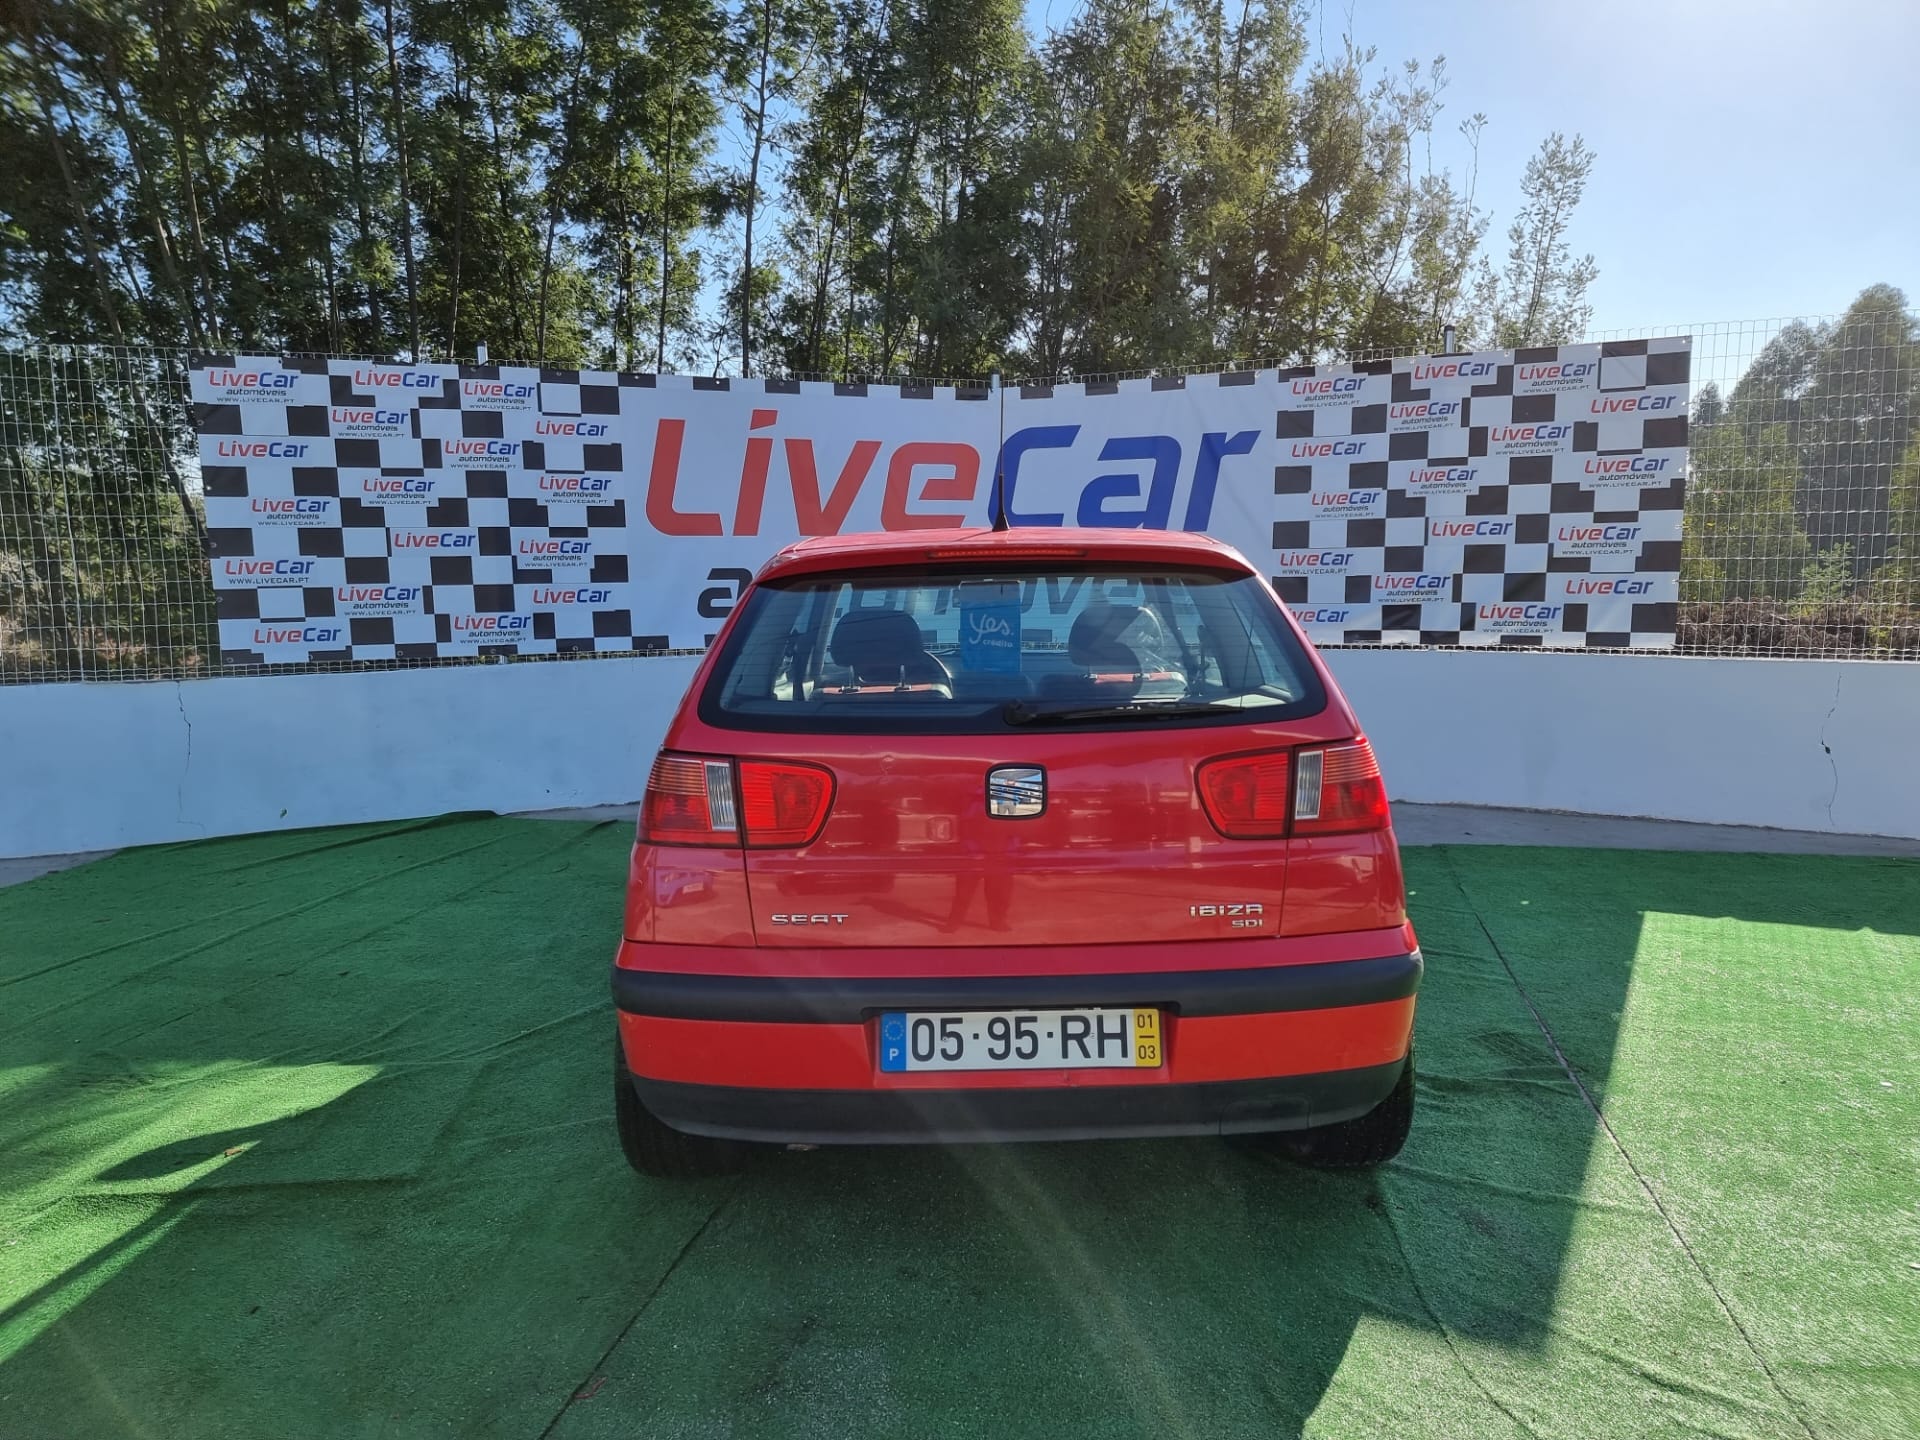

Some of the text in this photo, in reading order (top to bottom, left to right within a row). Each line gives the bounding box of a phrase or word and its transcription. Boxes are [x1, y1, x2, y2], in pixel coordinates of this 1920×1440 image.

[1415, 362, 1495, 380] LiveCar
[1518, 361, 1596, 380] LiveCar
[210, 370, 299, 389] LiveCar
[355, 370, 440, 388] LiveCar
[1291, 377, 1366, 395] LiveCar
[1531, 377, 1585, 387] automóveis
[226, 388, 286, 396] automóveis
[465, 382, 535, 398] LiveCar
[1304, 392, 1355, 402] automóveis
[477, 396, 526, 404] automóveis
[1591, 396, 1676, 413] LiveCar
[333, 409, 408, 424] LiveCar
[1390, 401, 1459, 419] LiveCar
[347, 423, 398, 431] automóveis
[1400, 415, 1448, 424] automóveis
[536, 420, 608, 436] LiveCar
[1492, 425, 1571, 441] LiveCar
[219, 441, 308, 458] LiveCar
[445, 440, 520, 456] LiveCar
[1292, 442, 1366, 457] LiveCar
[1504, 440, 1559, 449] automóveis
[646, 408, 1261, 537] LiveCar
[1585, 457, 1669, 474] LiveCar
[1410, 468, 1478, 482] LiveCar
[1597, 471, 1655, 481] automóveis
[364, 479, 435, 492] LiveCar
[540, 476, 611, 491] LiveCar
[1420, 480, 1466, 489] automóveis
[252, 498, 330, 512] LiveCar
[1312, 491, 1380, 506] LiveCar
[1322, 504, 1368, 512] automóveis
[1432, 521, 1513, 536] LiveCar
[1559, 526, 1641, 542] LiveCar
[395, 533, 476, 547] LiveCar
[520, 540, 591, 553] LiveCar
[1280, 552, 1354, 566] LiveCar
[226, 560, 315, 574] LiveCar
[1375, 575, 1451, 589] LiveCar
[1566, 579, 1653, 594] LiveCar
[338, 586, 420, 602] LiveCar
[533, 588, 612, 604] LiveCar
[352, 600, 408, 609] automóveis
[1480, 604, 1561, 619] LiveCar
[455, 615, 531, 630] LiveCar
[255, 628, 342, 643] LiveCar
[1190, 904, 1263, 917] IBIZA
[771, 914, 849, 925] SEAT
[1231, 919, 1263, 928] SDI
[1137, 1014, 1153, 1029] 01
[889, 1048, 899, 1061] P
[1138, 1045, 1156, 1060] 03
